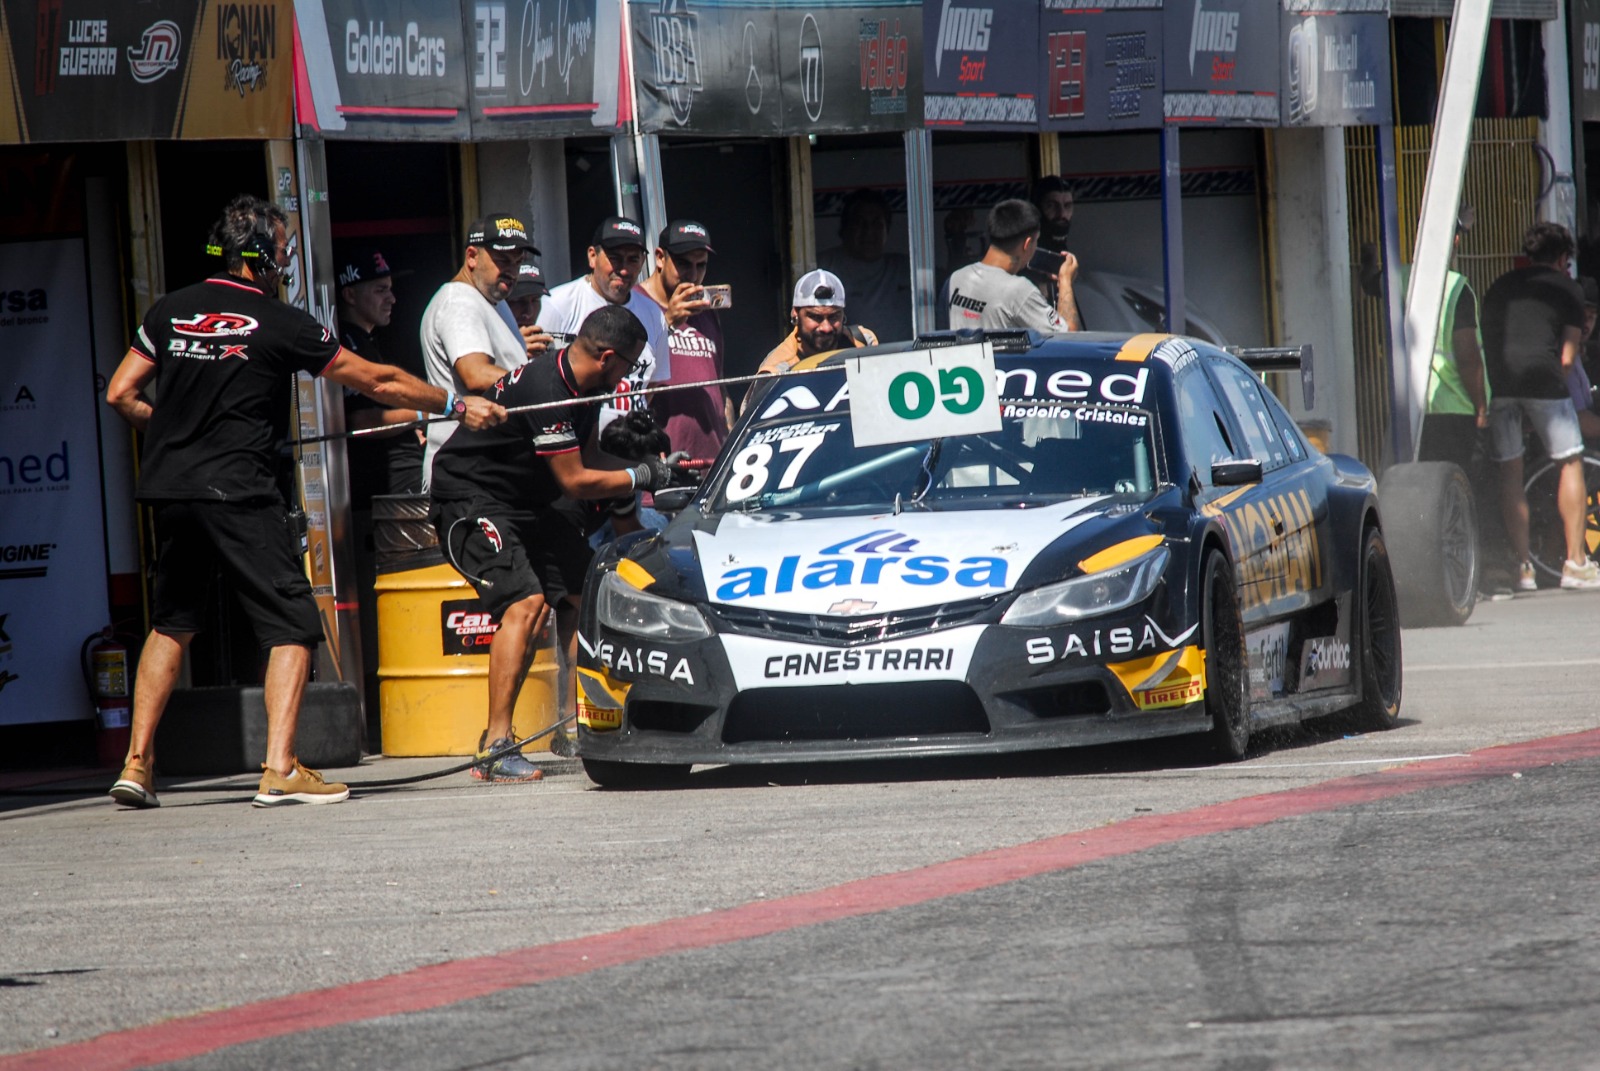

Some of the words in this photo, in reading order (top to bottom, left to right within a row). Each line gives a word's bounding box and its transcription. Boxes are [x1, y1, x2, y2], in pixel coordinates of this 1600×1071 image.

[68, 20, 107, 42] LUCAS
[217, 4, 276, 60] KONAN
[346, 19, 402, 75] Golden
[406, 22, 446, 77] Cars
[475, 5, 506, 92] 32
[59, 47, 117, 75] GUERRA
[653, 15, 701, 85] IBBA
[1323, 34, 1358, 72] Michell
[230, 59, 262, 98] Racing
[958, 55, 987, 86] Sport
[1211, 55, 1237, 82] Sport
[1, 316, 15, 326] del
[17, 315, 49, 325] bronce
[668, 335, 717, 353] OLLISTER
[1003, 405, 1071, 419] Rodolfo
[1075, 407, 1147, 426] Cristales
[725, 432, 826, 502] 87
[716, 555, 1009, 601] alarsa
[446, 610, 493, 629] Car
[1026, 624, 1156, 665] SAISA
[601, 643, 695, 685] SAISA
[764, 647, 954, 680] CANESTRARI
[1144, 680, 1202, 706] PIRELLI
